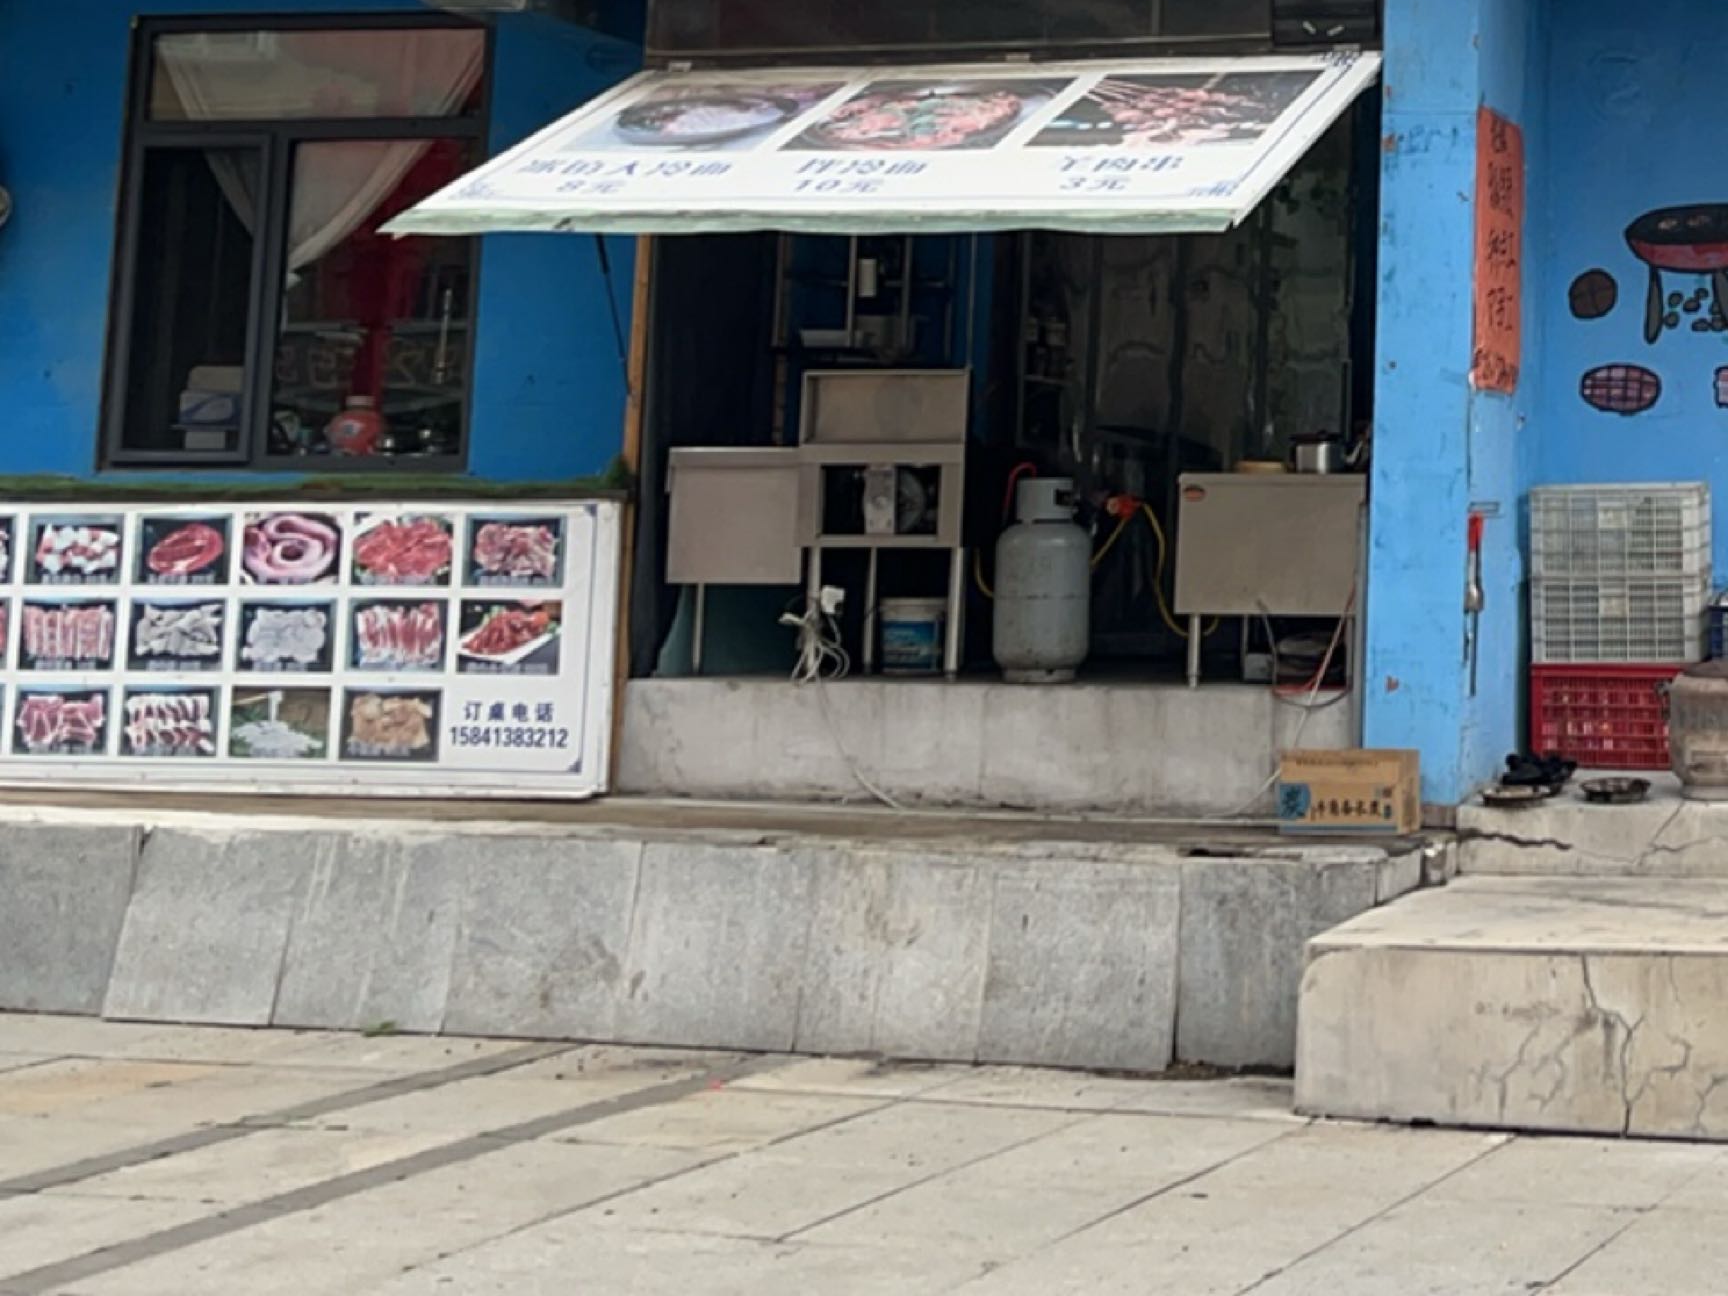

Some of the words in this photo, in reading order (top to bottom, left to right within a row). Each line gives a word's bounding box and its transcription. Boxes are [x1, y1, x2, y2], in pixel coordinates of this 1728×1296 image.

[463, 701, 555, 723] 订桌电话
[449, 725, 569, 749] 15841383212
